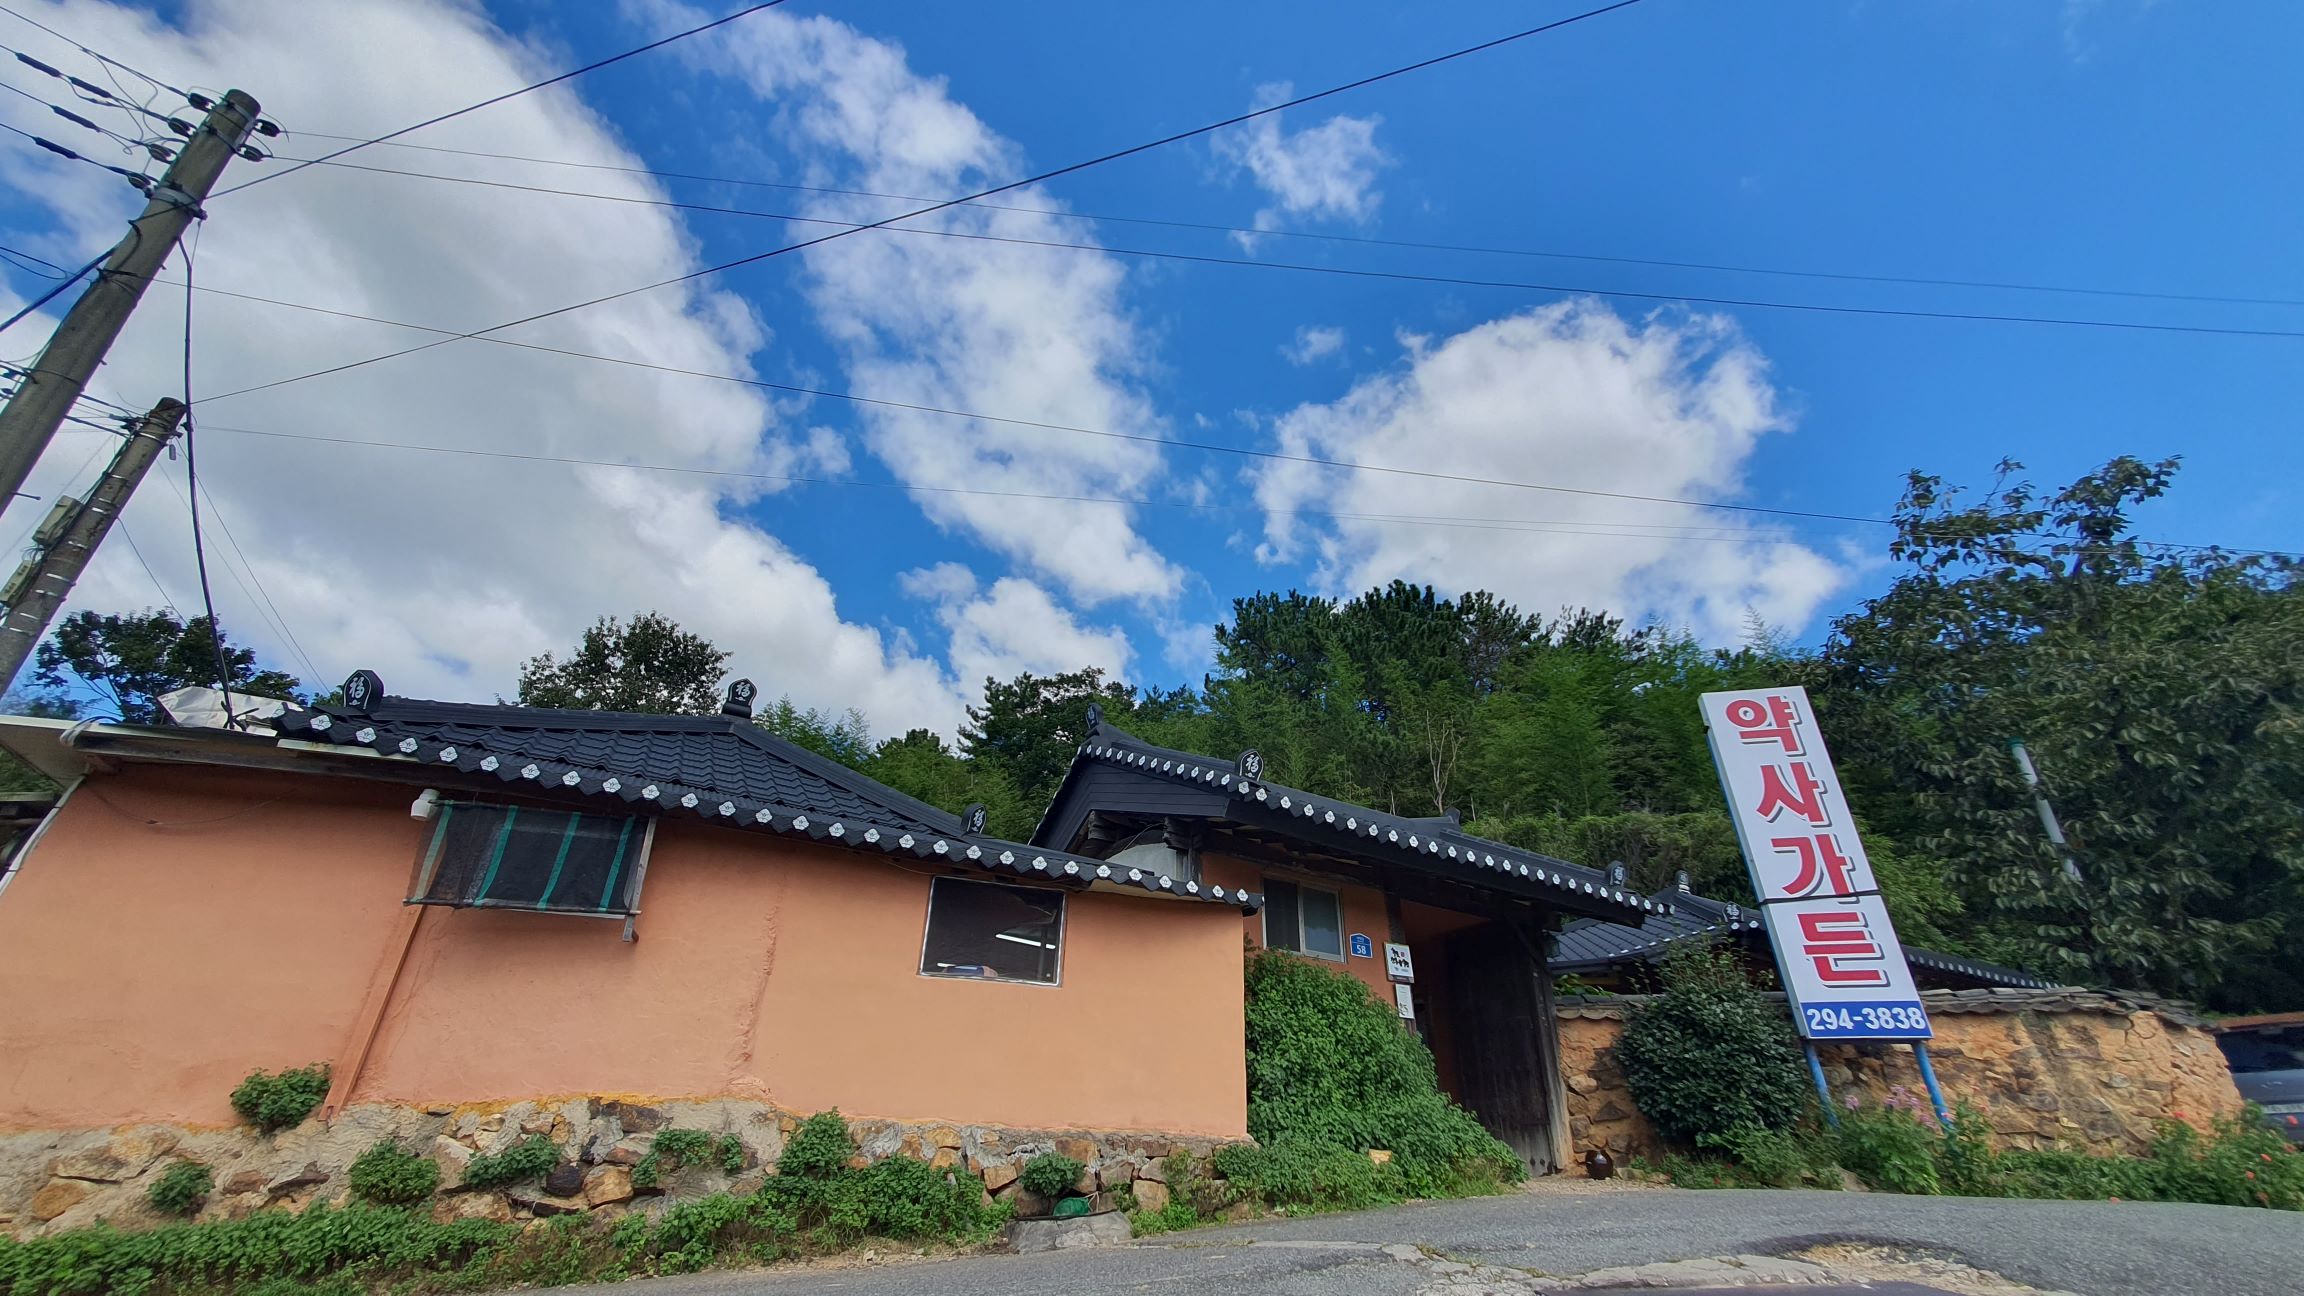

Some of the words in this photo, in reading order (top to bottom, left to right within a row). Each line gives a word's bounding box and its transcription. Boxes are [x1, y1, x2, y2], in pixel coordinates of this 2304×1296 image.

[1725, 695, 1890, 987] 약사가든
[1356, 944, 1367, 955] 58
[1806, 1007, 1927, 1032] 294-3838
